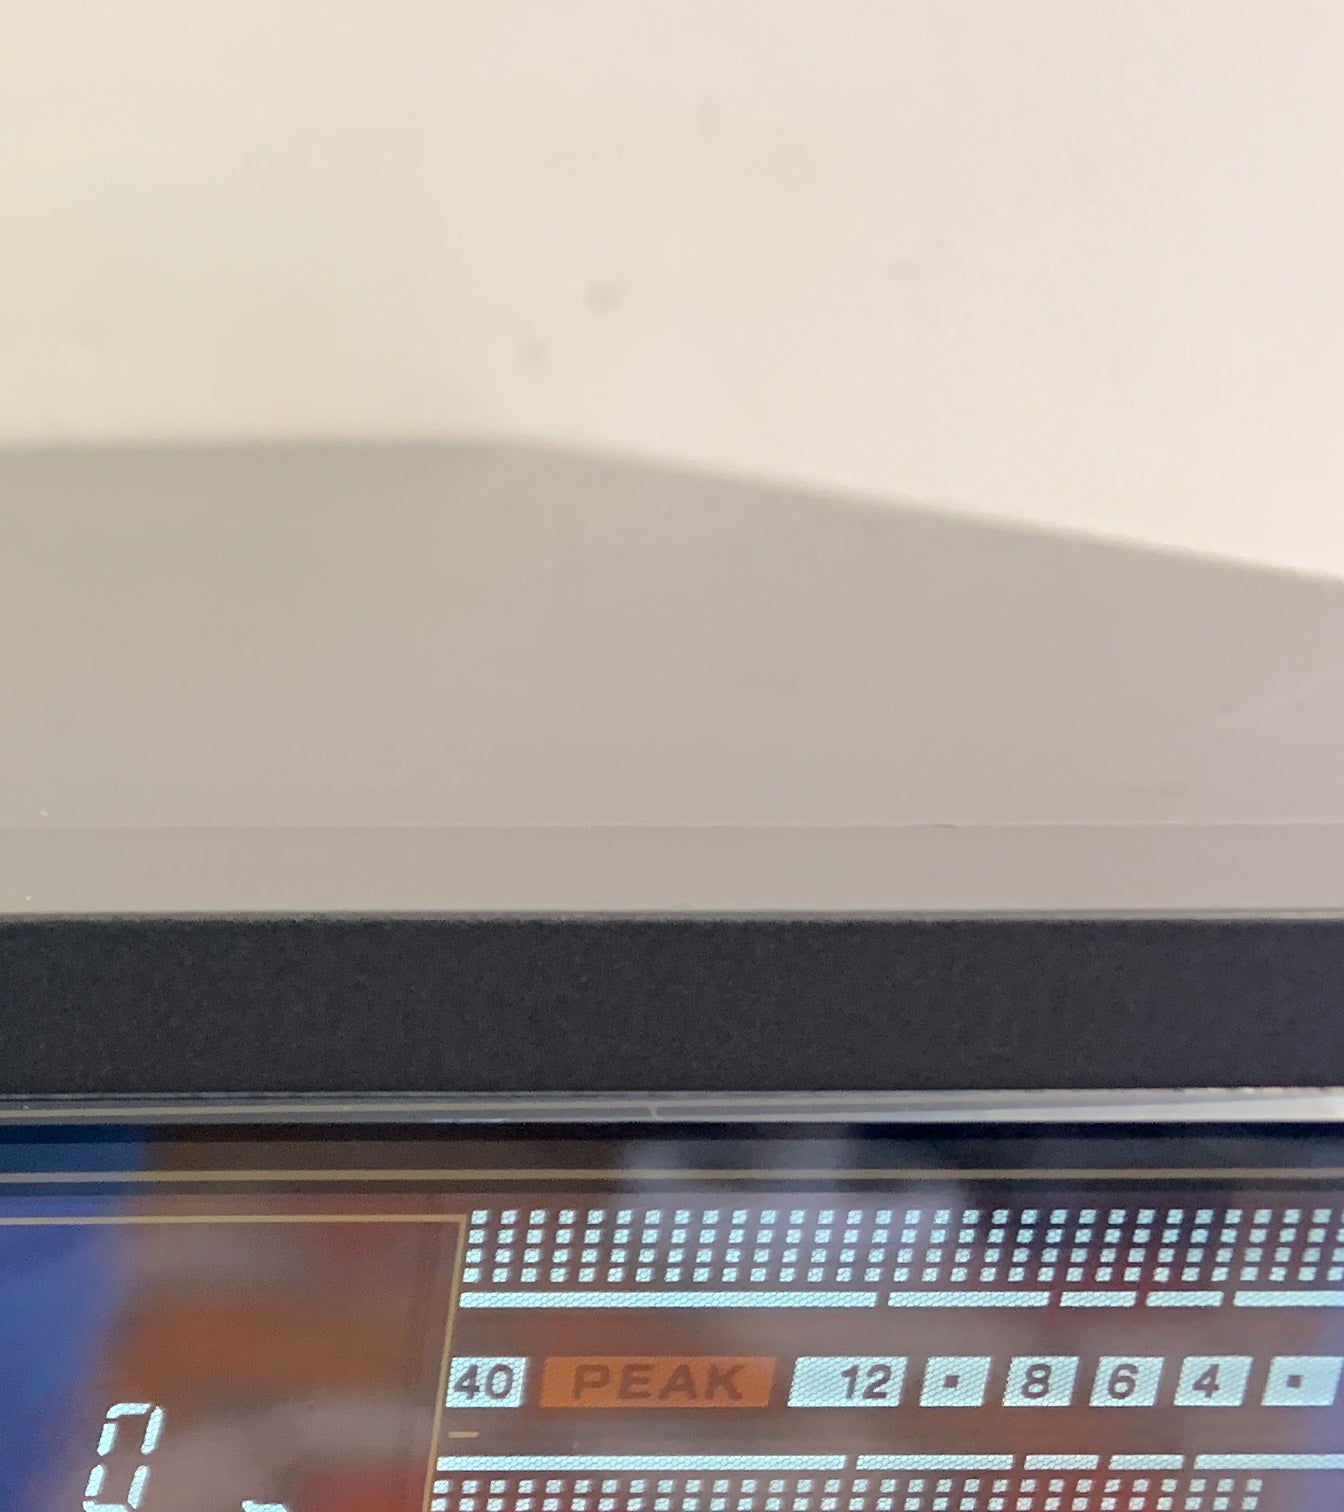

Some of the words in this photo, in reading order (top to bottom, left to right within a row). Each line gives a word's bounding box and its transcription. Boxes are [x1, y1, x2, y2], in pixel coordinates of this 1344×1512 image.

[453, 1364, 515, 1400] 40
[572, 1364, 747, 1400] PEAK
[839, 1364, 892, 1400] 12
[1018, 1364, 1052, 1400] 8
[1104, 1364, 1140, 1400] 6
[1191, 1364, 1222, 1400] 4
